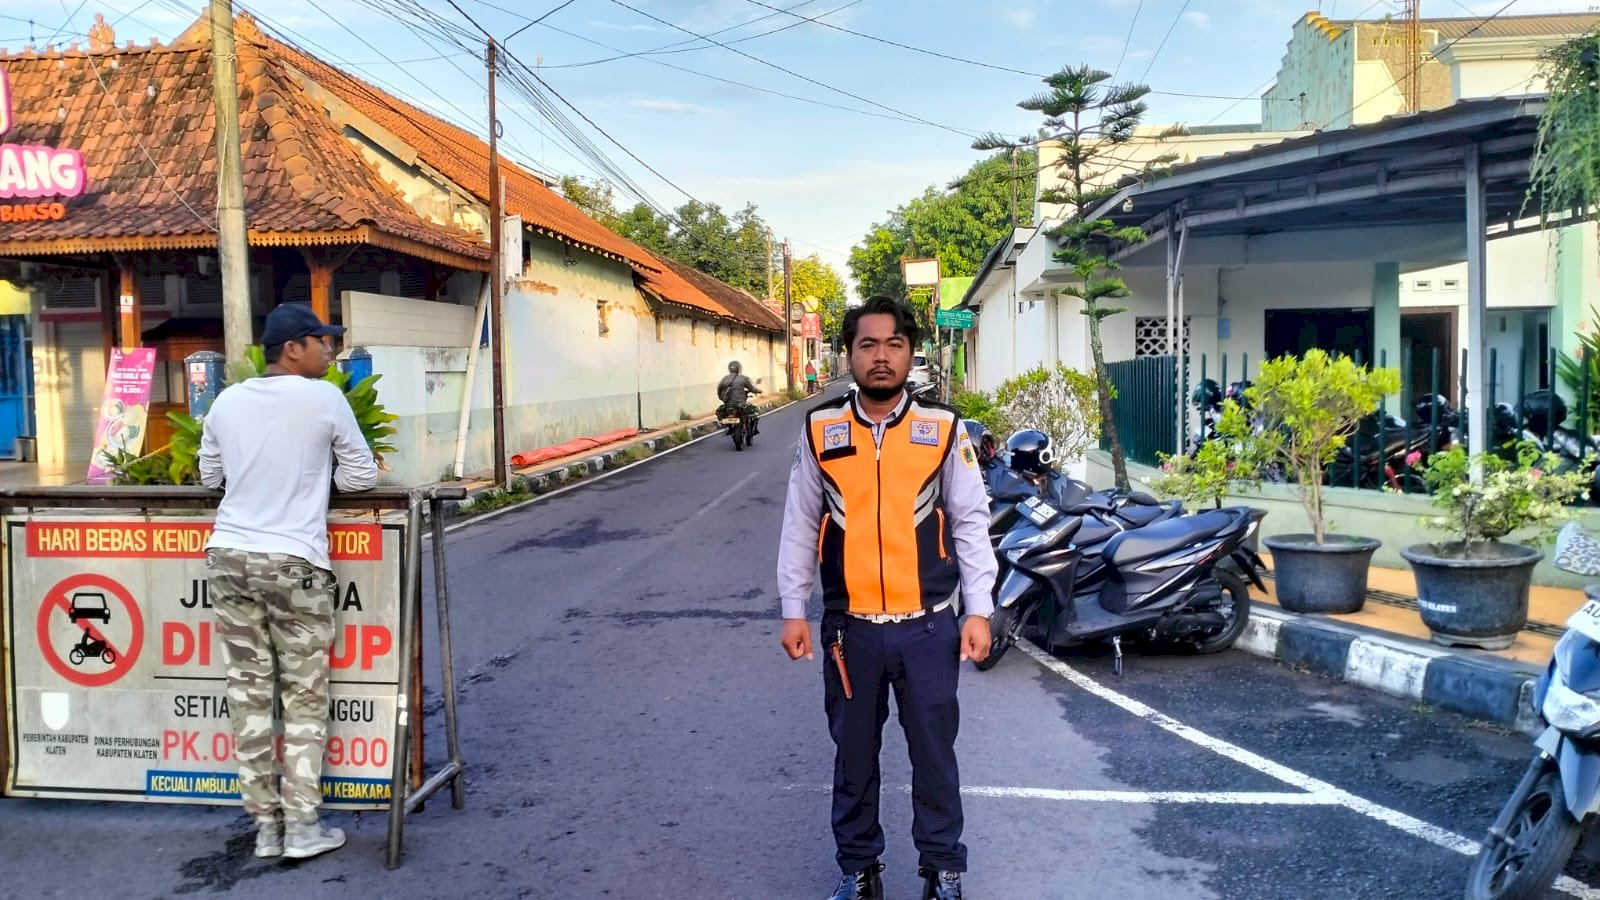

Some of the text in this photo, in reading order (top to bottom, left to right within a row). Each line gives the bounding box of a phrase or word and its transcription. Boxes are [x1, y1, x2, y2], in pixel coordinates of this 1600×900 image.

[0, 202, 65, 221] BAKSO
[38, 528, 80, 551] HARI
[85, 528, 147, 551] BEBAS
[174, 695, 374, 722] SETIA NGGU
[23, 734, 89, 744] PEMERINTAH KABUPATEN
[94, 736, 160, 748] DINAS PERHUBUNGAN
[45, 746, 66, 755] KLATEN
[96, 748, 158, 760] KABUPATEN KLATEN
[151, 775, 193, 793] KECUALI
[334, 781, 392, 800] KEBAKARA
